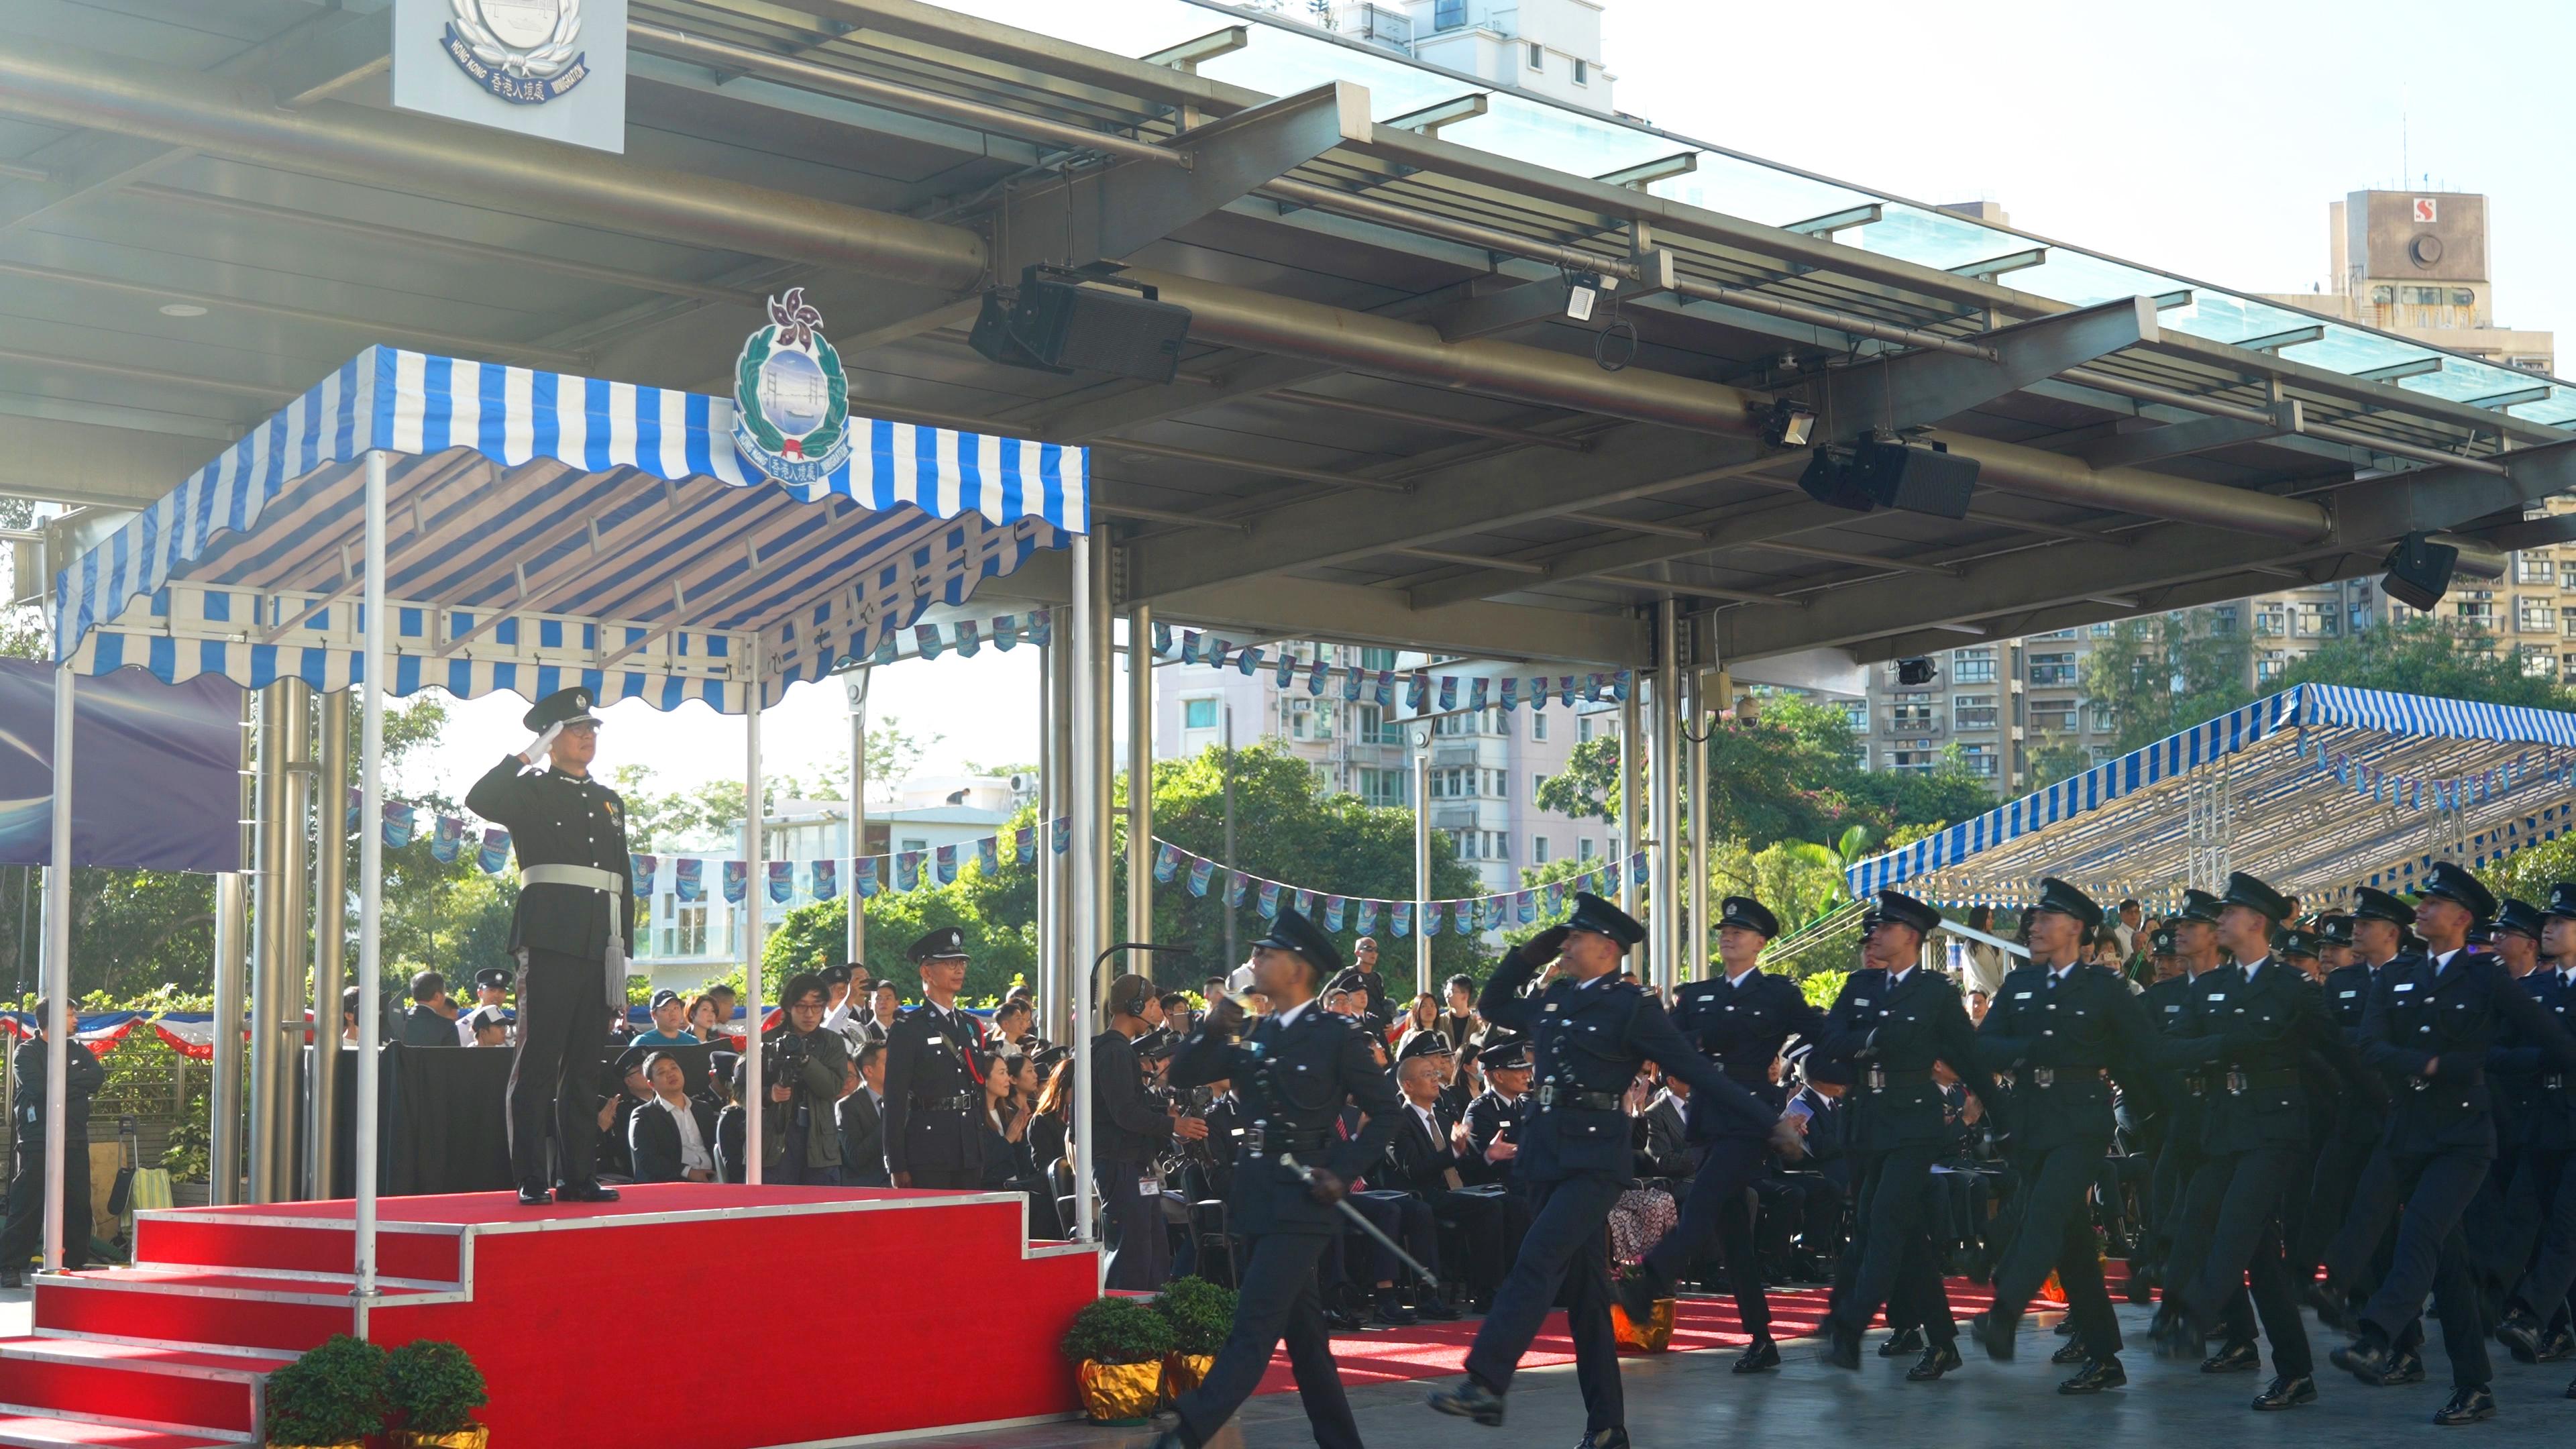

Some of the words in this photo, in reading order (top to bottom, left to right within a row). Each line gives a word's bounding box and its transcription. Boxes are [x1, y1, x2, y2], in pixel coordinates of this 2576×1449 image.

[451, 40, 468, 63] HONG
[467, 59, 487, 78] KONG
[739, 432, 754, 453] HONG
[751, 449, 768, 466] KONG
